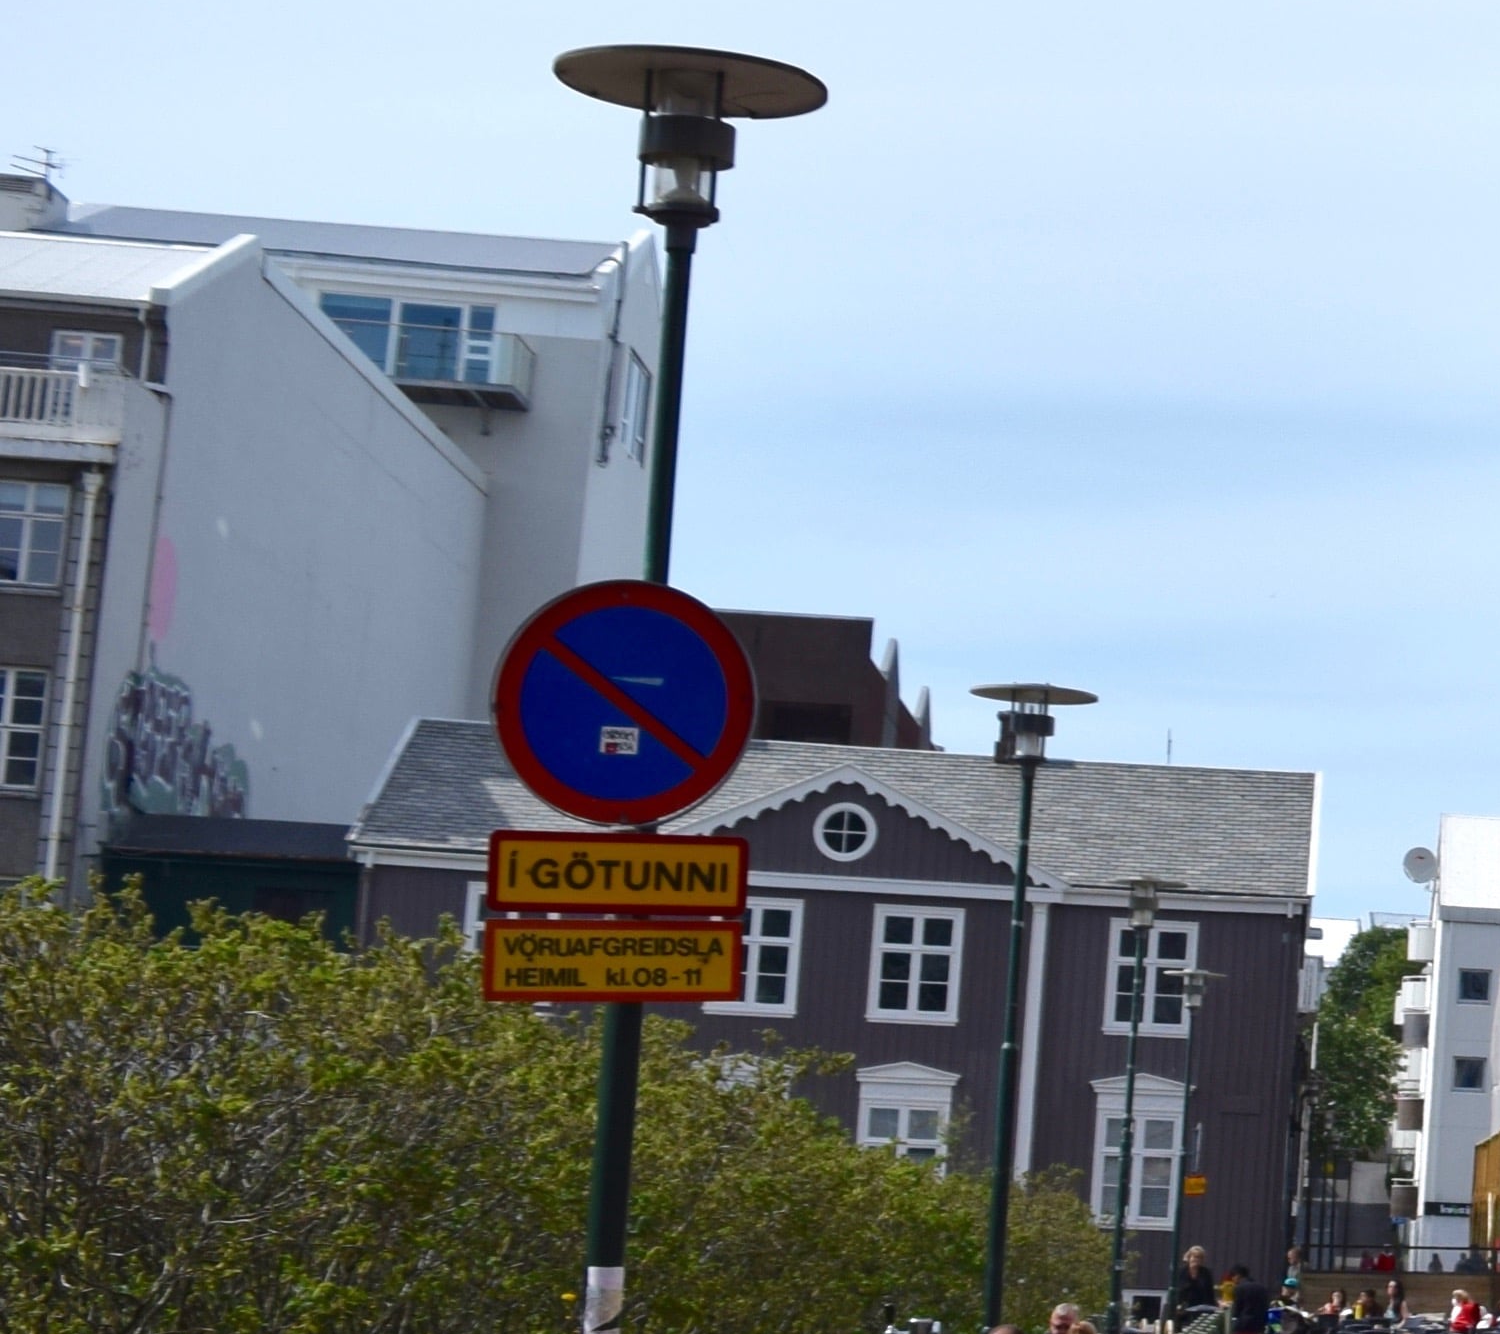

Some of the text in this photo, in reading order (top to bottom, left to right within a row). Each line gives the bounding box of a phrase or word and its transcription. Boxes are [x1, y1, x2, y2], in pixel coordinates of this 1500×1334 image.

[508, 850, 729, 894] Í GÖTUNNI
[504, 967, 588, 987] HEIMIL
